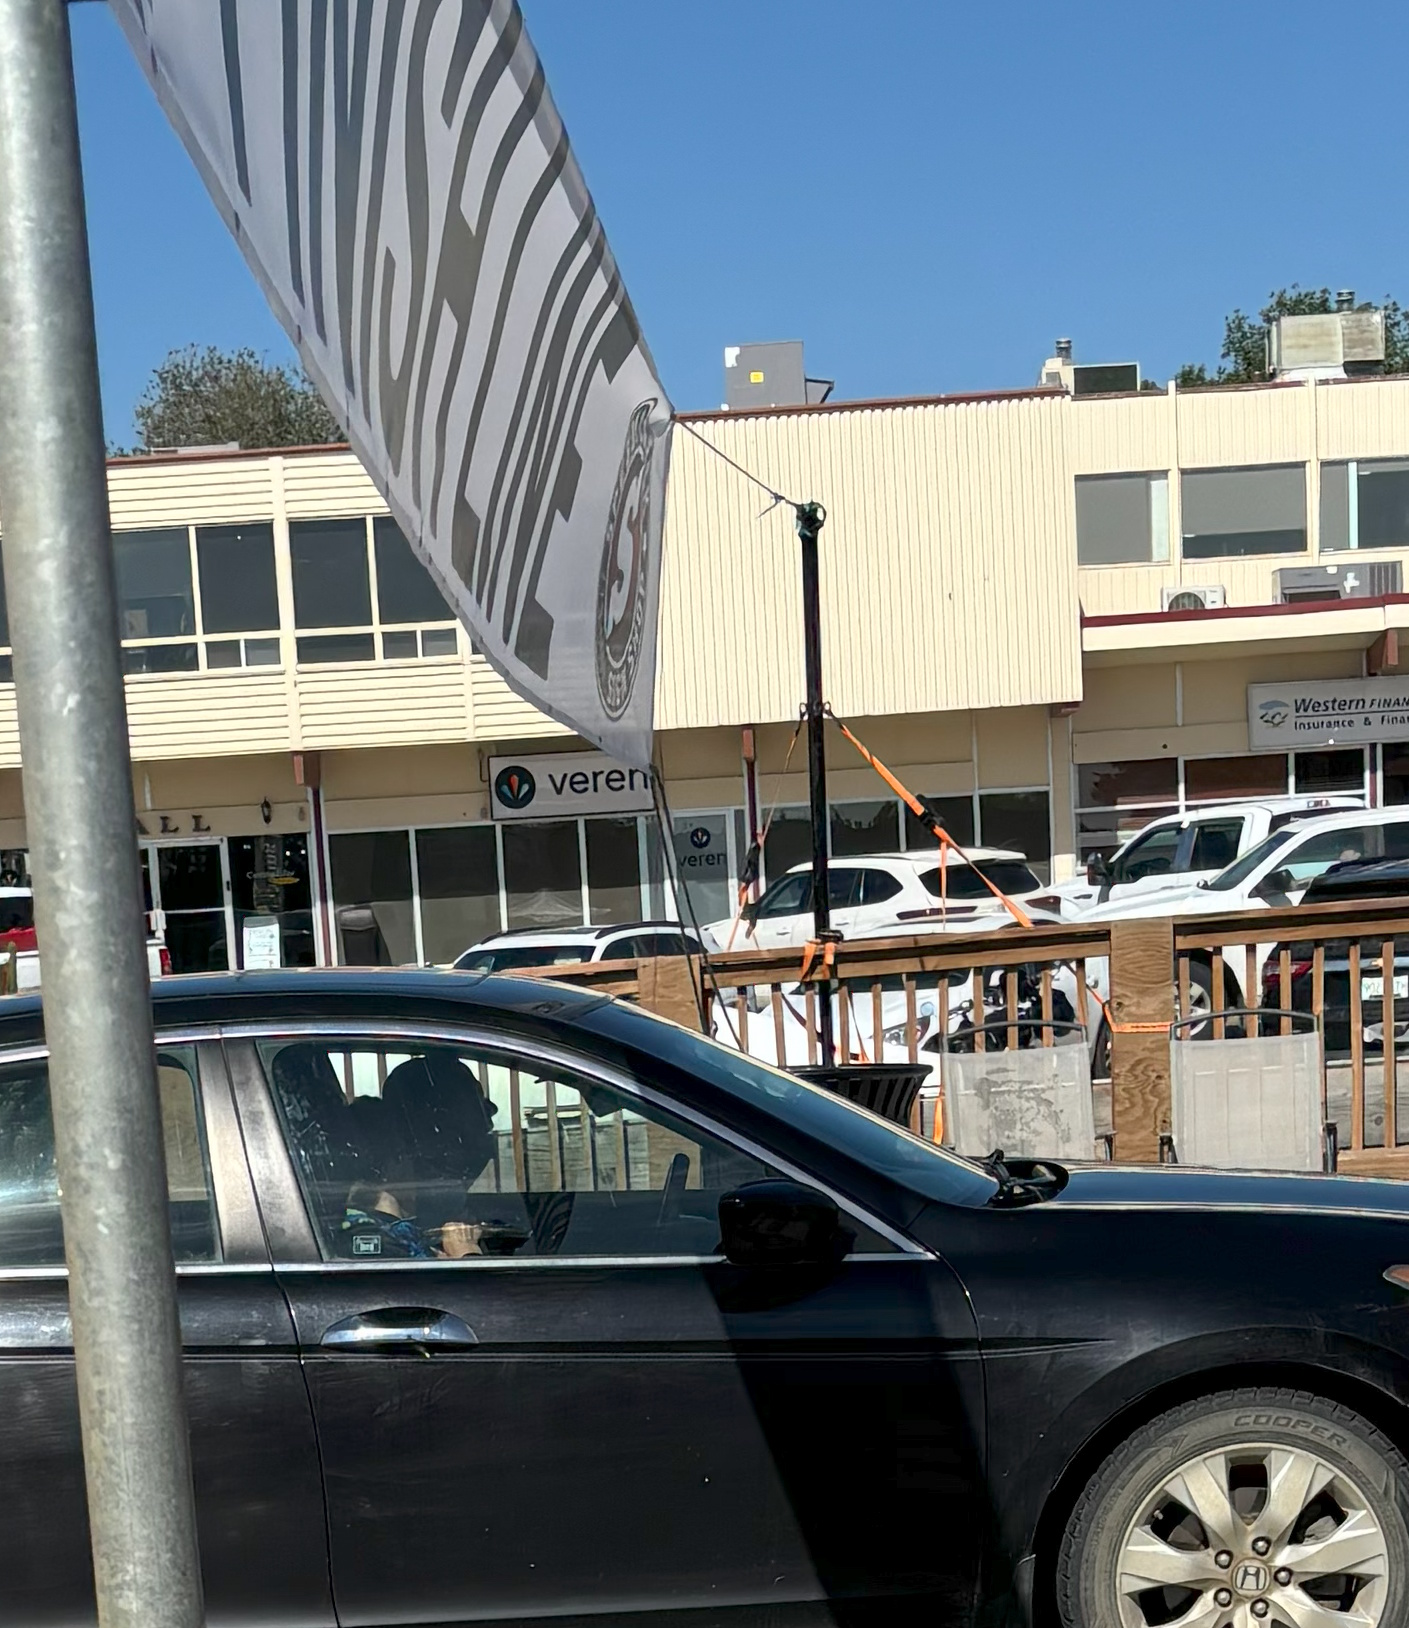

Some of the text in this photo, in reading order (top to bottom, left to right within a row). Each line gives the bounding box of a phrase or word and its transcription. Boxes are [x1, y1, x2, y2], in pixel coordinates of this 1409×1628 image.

[451, 120, 639, 683] LINE
[1294, 697, 1366, 714] Western
[1294, 717, 1355, 731] Insurance
[1363, 716, 1372, 727] &
[548, 768, 648, 796] veren
[678, 852, 727, 868] veren
[1233, 1414, 1348, 1447] COOPER
